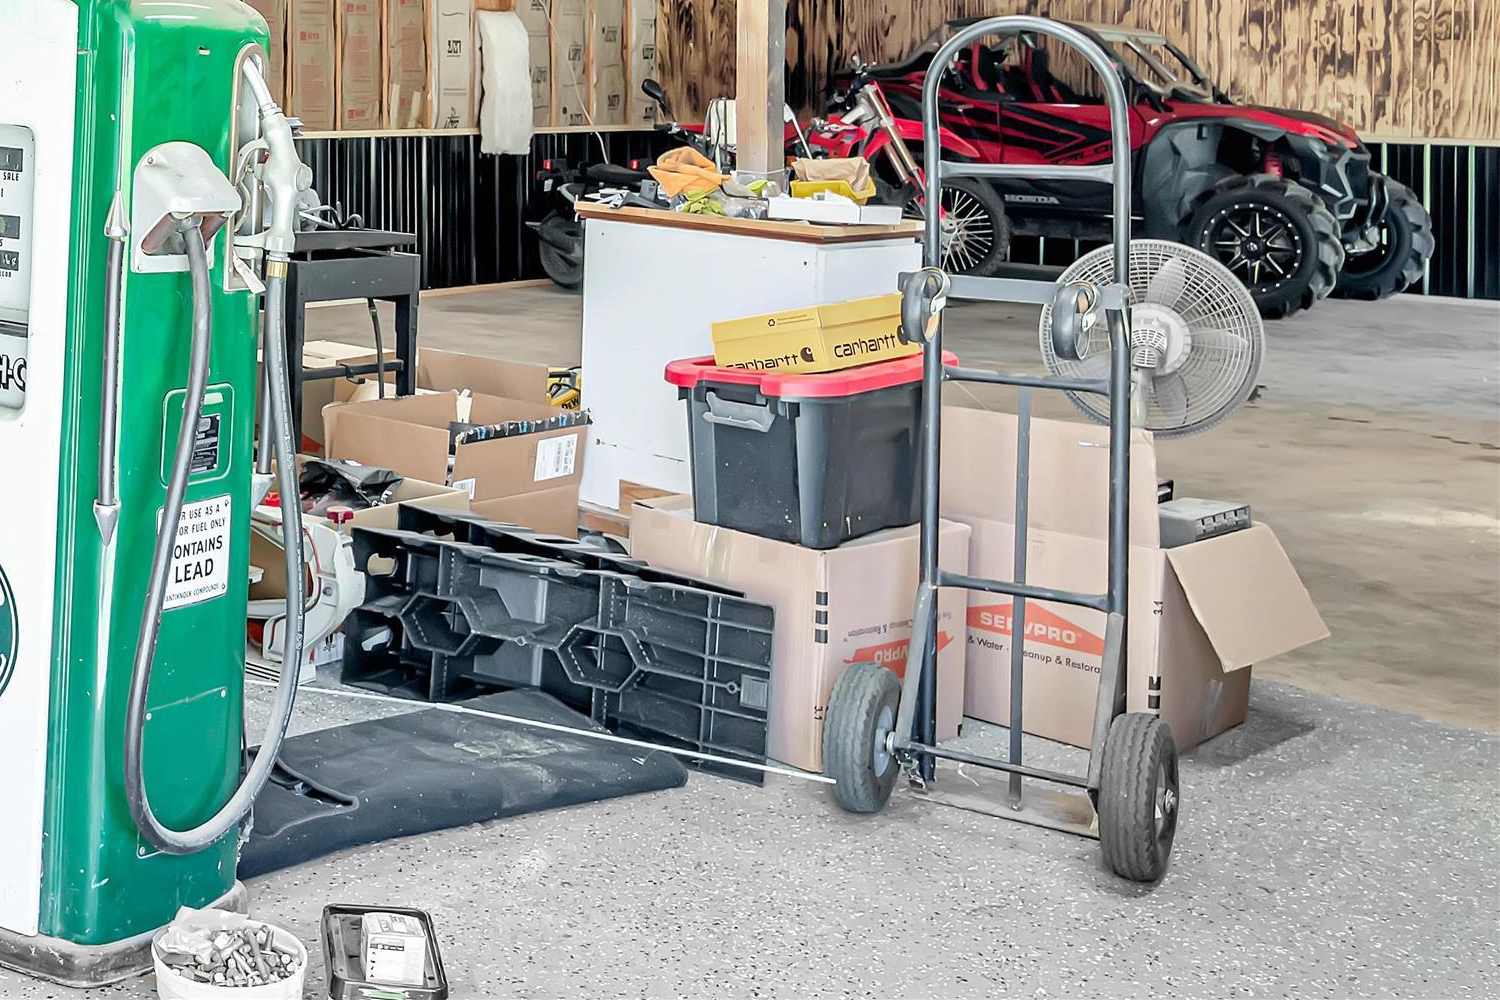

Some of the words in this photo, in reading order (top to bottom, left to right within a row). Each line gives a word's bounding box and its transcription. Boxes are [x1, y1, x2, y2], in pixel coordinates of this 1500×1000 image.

[3, 171, 19, 181] SALE
[834, 333, 895, 358] carhartt
[726, 353, 798, 371] arhartt
[189, 508, 202, 520] USE
[205, 505, 213, 516] AS
[215, 504, 220, 513] A
[191, 521, 207, 534] FUEL
[211, 517, 226, 529] ONLY
[174, 535, 223, 559] ONTAINS
[175, 558, 214, 584] LEAD
[166, 590, 192, 602] ANTIKNOCK
[193, 583, 220, 596] COMPOUNDS
[967, 635, 975, 644] &
[977, 637, 1003, 652] Water
[1023, 650, 1052, 664] eanup
[1055, 656, 1063, 666] &
[1065, 658, 1101, 674] Restora
